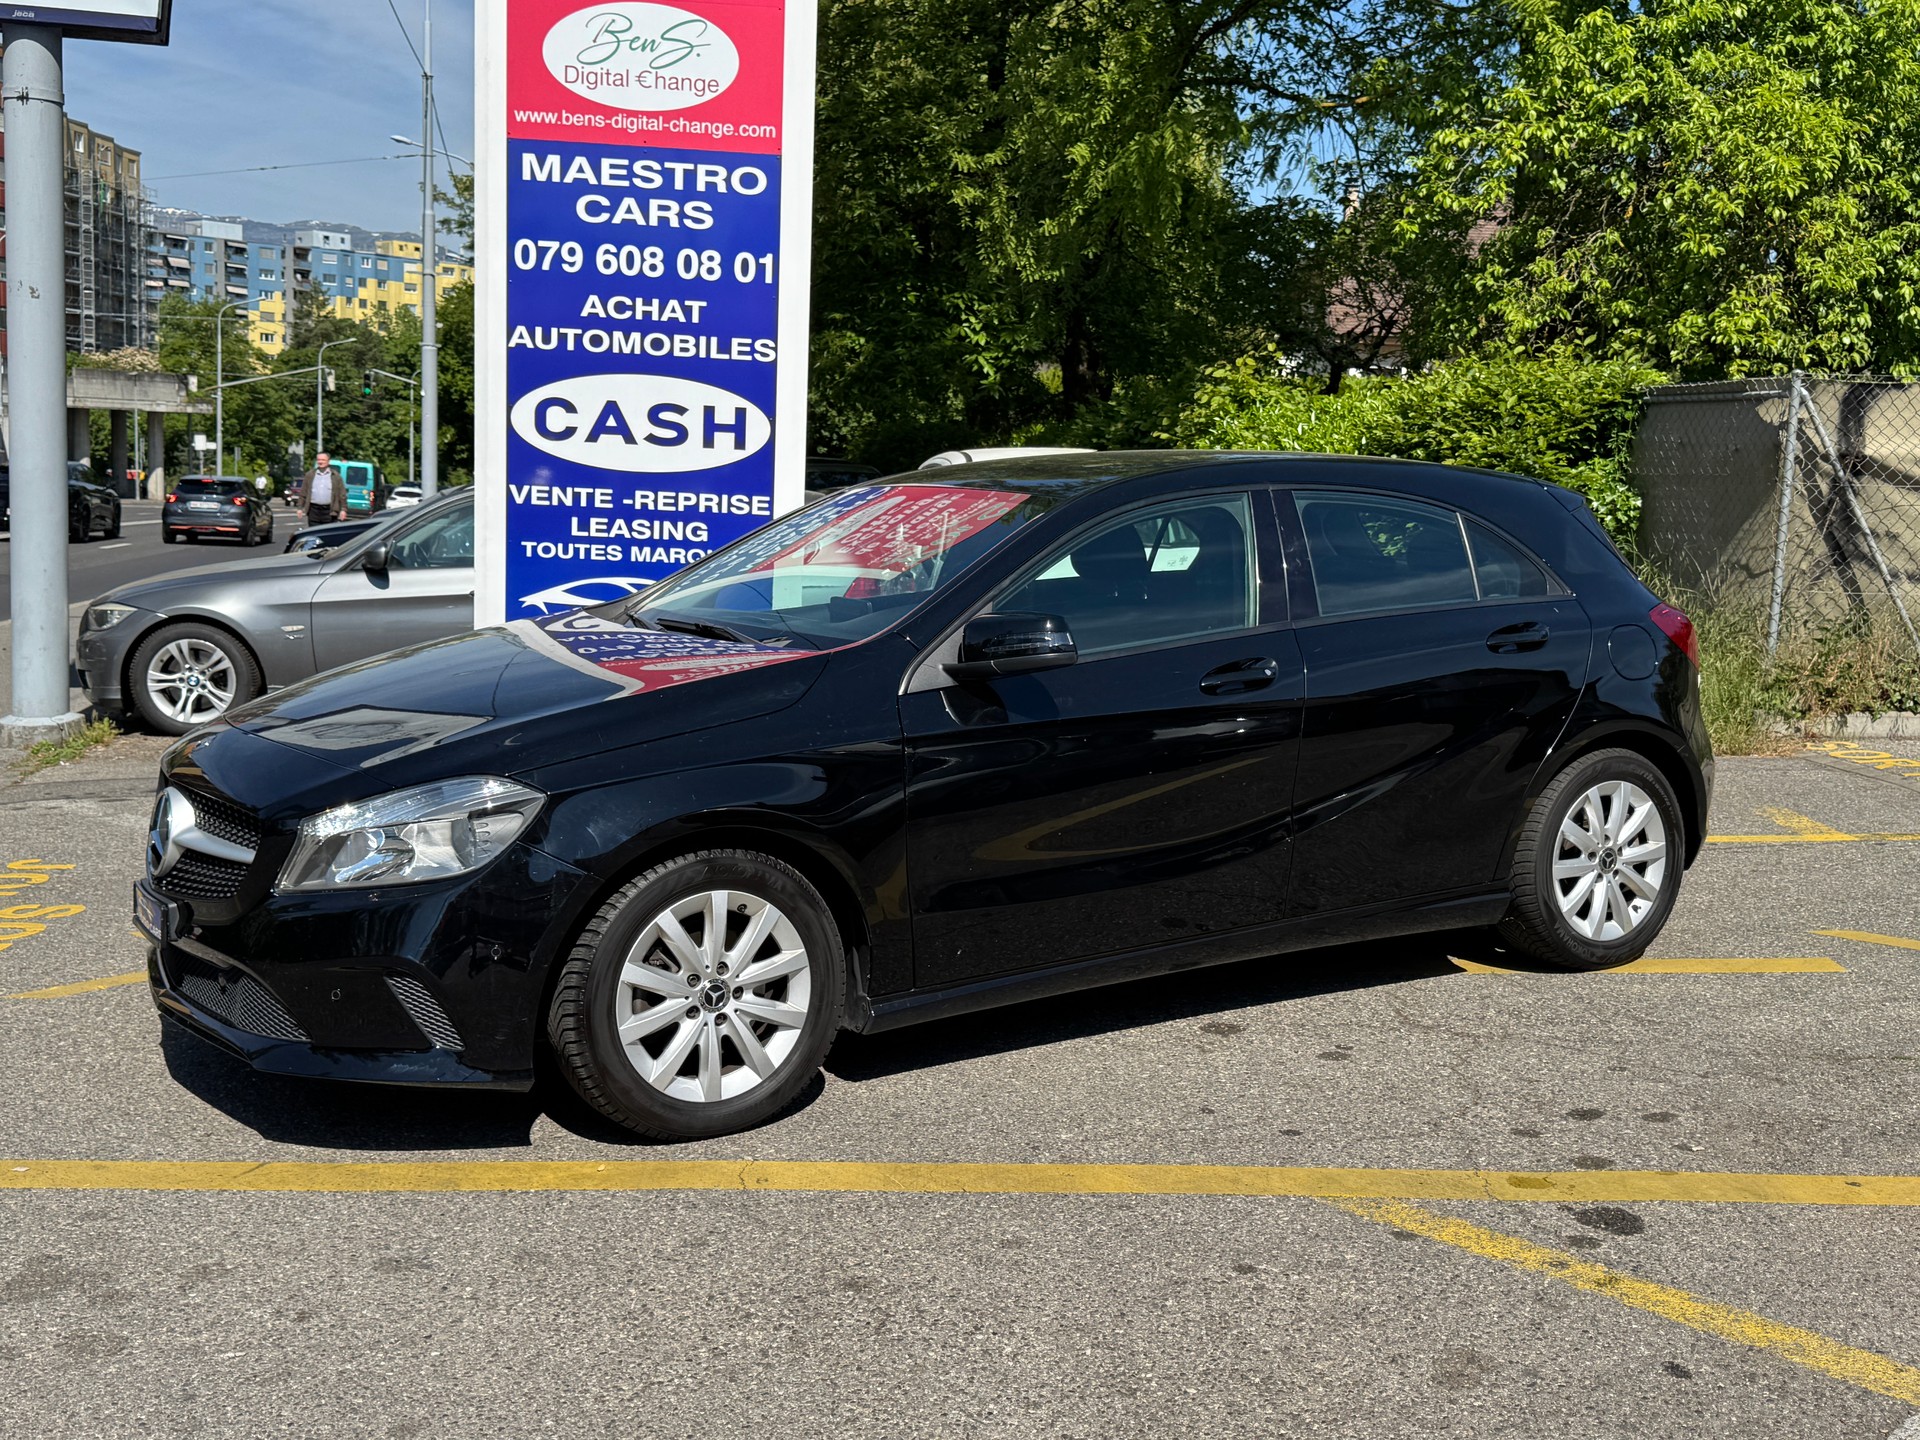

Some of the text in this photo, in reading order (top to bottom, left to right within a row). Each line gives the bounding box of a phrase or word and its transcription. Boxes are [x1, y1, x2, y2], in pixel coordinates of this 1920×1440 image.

[564, 65, 629, 90] Digital
[514, 110, 776, 138] www.bens-digital-change.com
[521, 153, 768, 196] MAESTRO
[576, 195, 714, 230] CARS
[514, 239, 774, 284] 079 608 08 01
[580, 295, 707, 324] ACHAT
[508, 326, 777, 362] AUTOMOBILES
[534, 397, 747, 451] CASH
[509, 484, 613, 509] VENTE
[571, 517, 709, 541] LEASING
[521, 541, 713, 564] TOUTES MARQ
